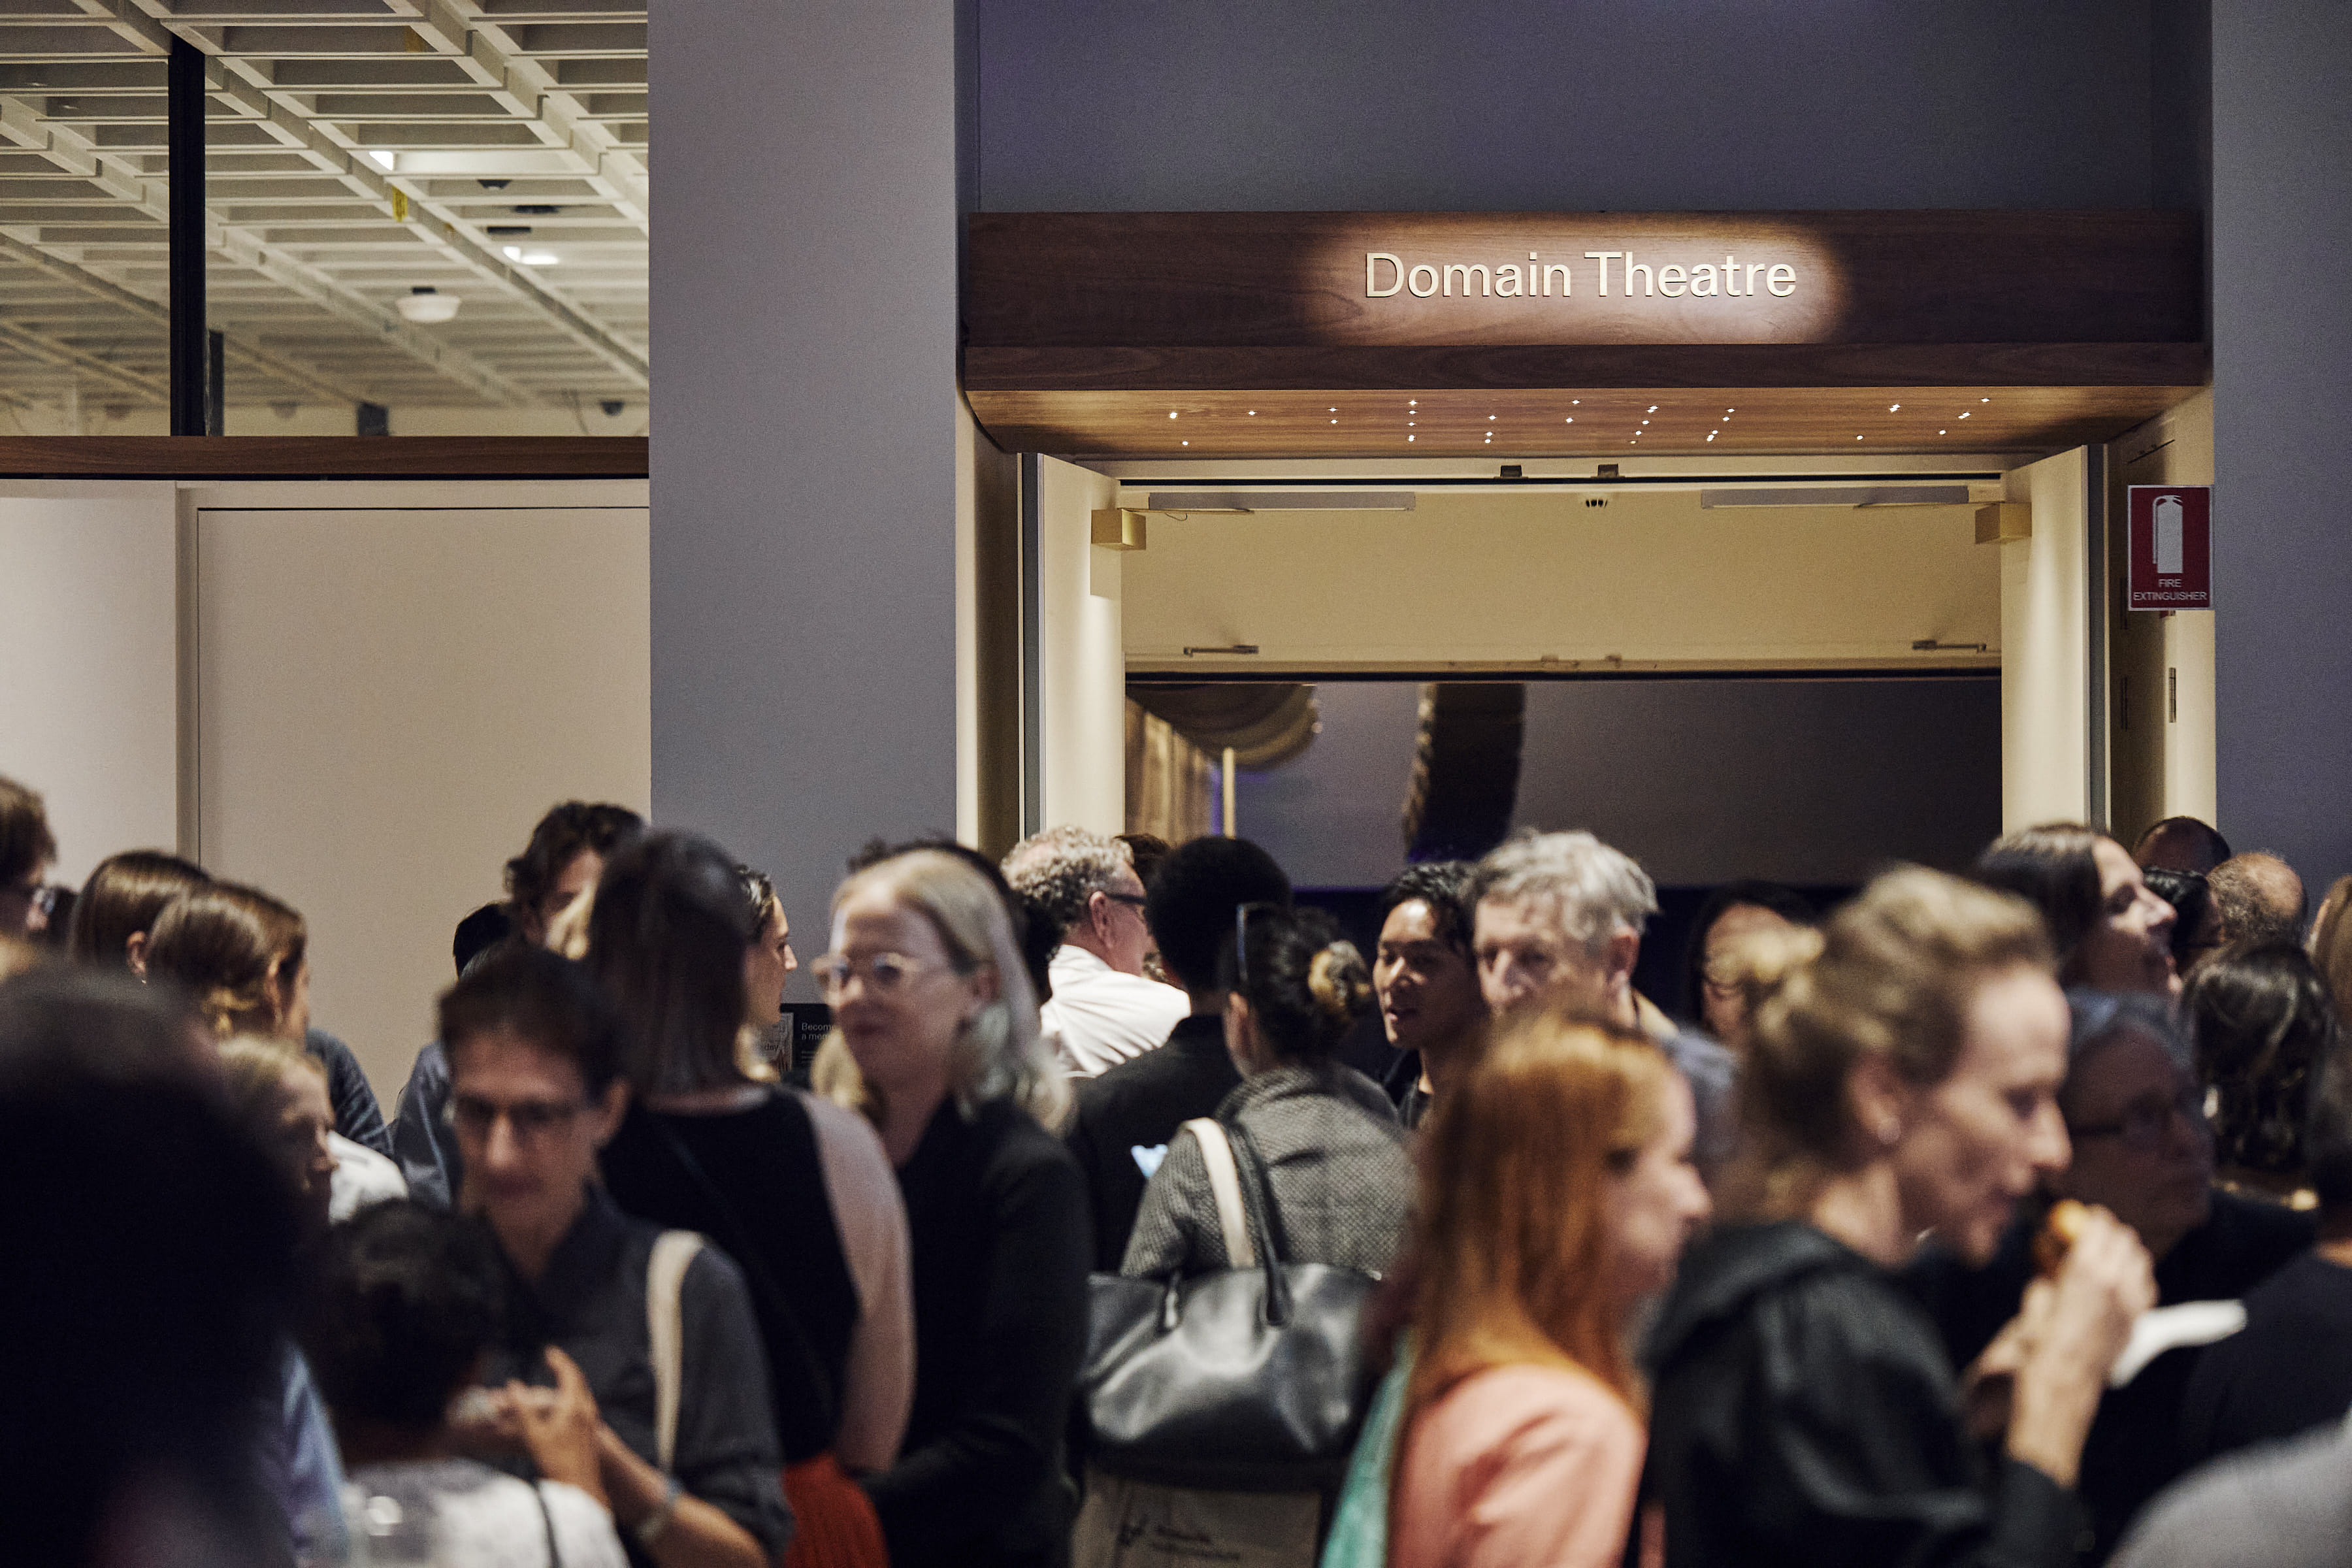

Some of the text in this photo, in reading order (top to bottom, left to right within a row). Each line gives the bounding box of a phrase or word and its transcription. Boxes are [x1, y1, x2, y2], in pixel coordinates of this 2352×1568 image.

[1366, 252, 1797, 297] Domain Theatre
[2159, 579, 2182, 587] FIRE
[2133, 591, 2208, 600] EXTINGUISHER
[801, 1022, 833, 1030] Becom
